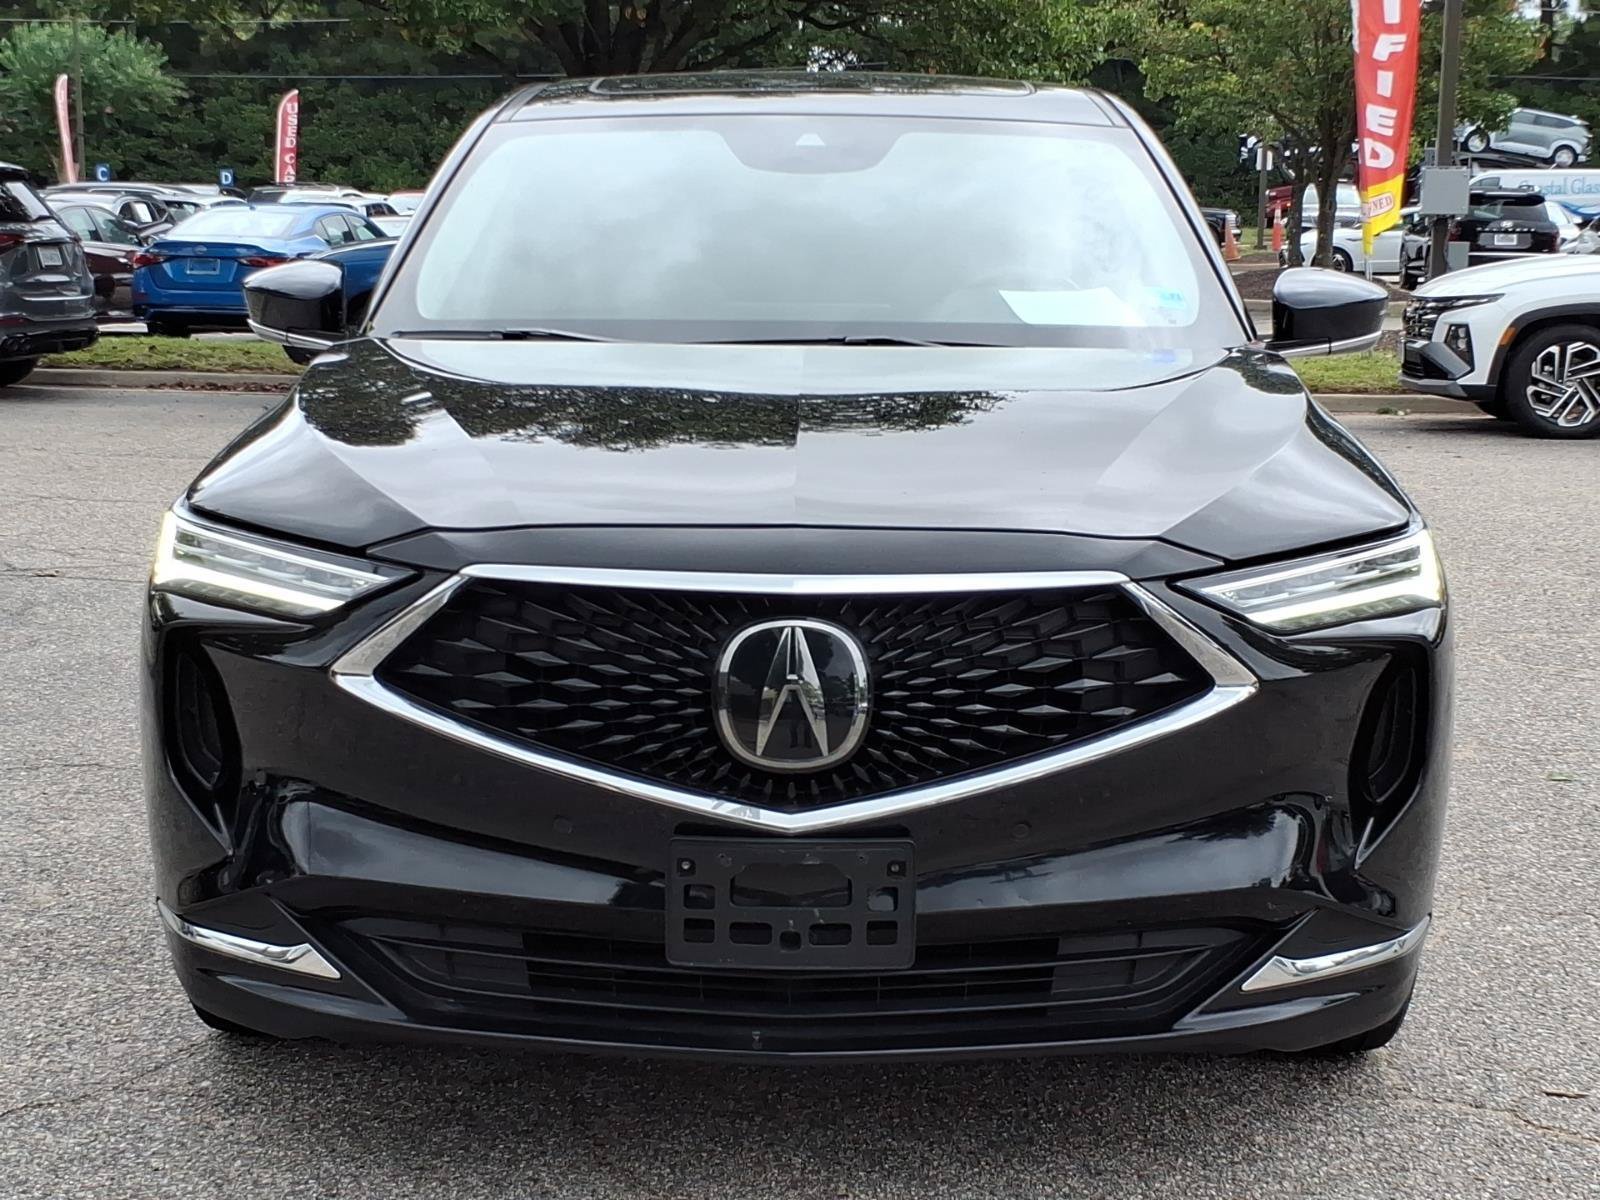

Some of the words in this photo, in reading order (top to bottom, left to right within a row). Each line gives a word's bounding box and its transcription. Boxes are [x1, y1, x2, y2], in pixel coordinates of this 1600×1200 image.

[285, 102, 298, 148] USED
[97, 167, 108, 182] C
[221, 171, 232, 185] D
